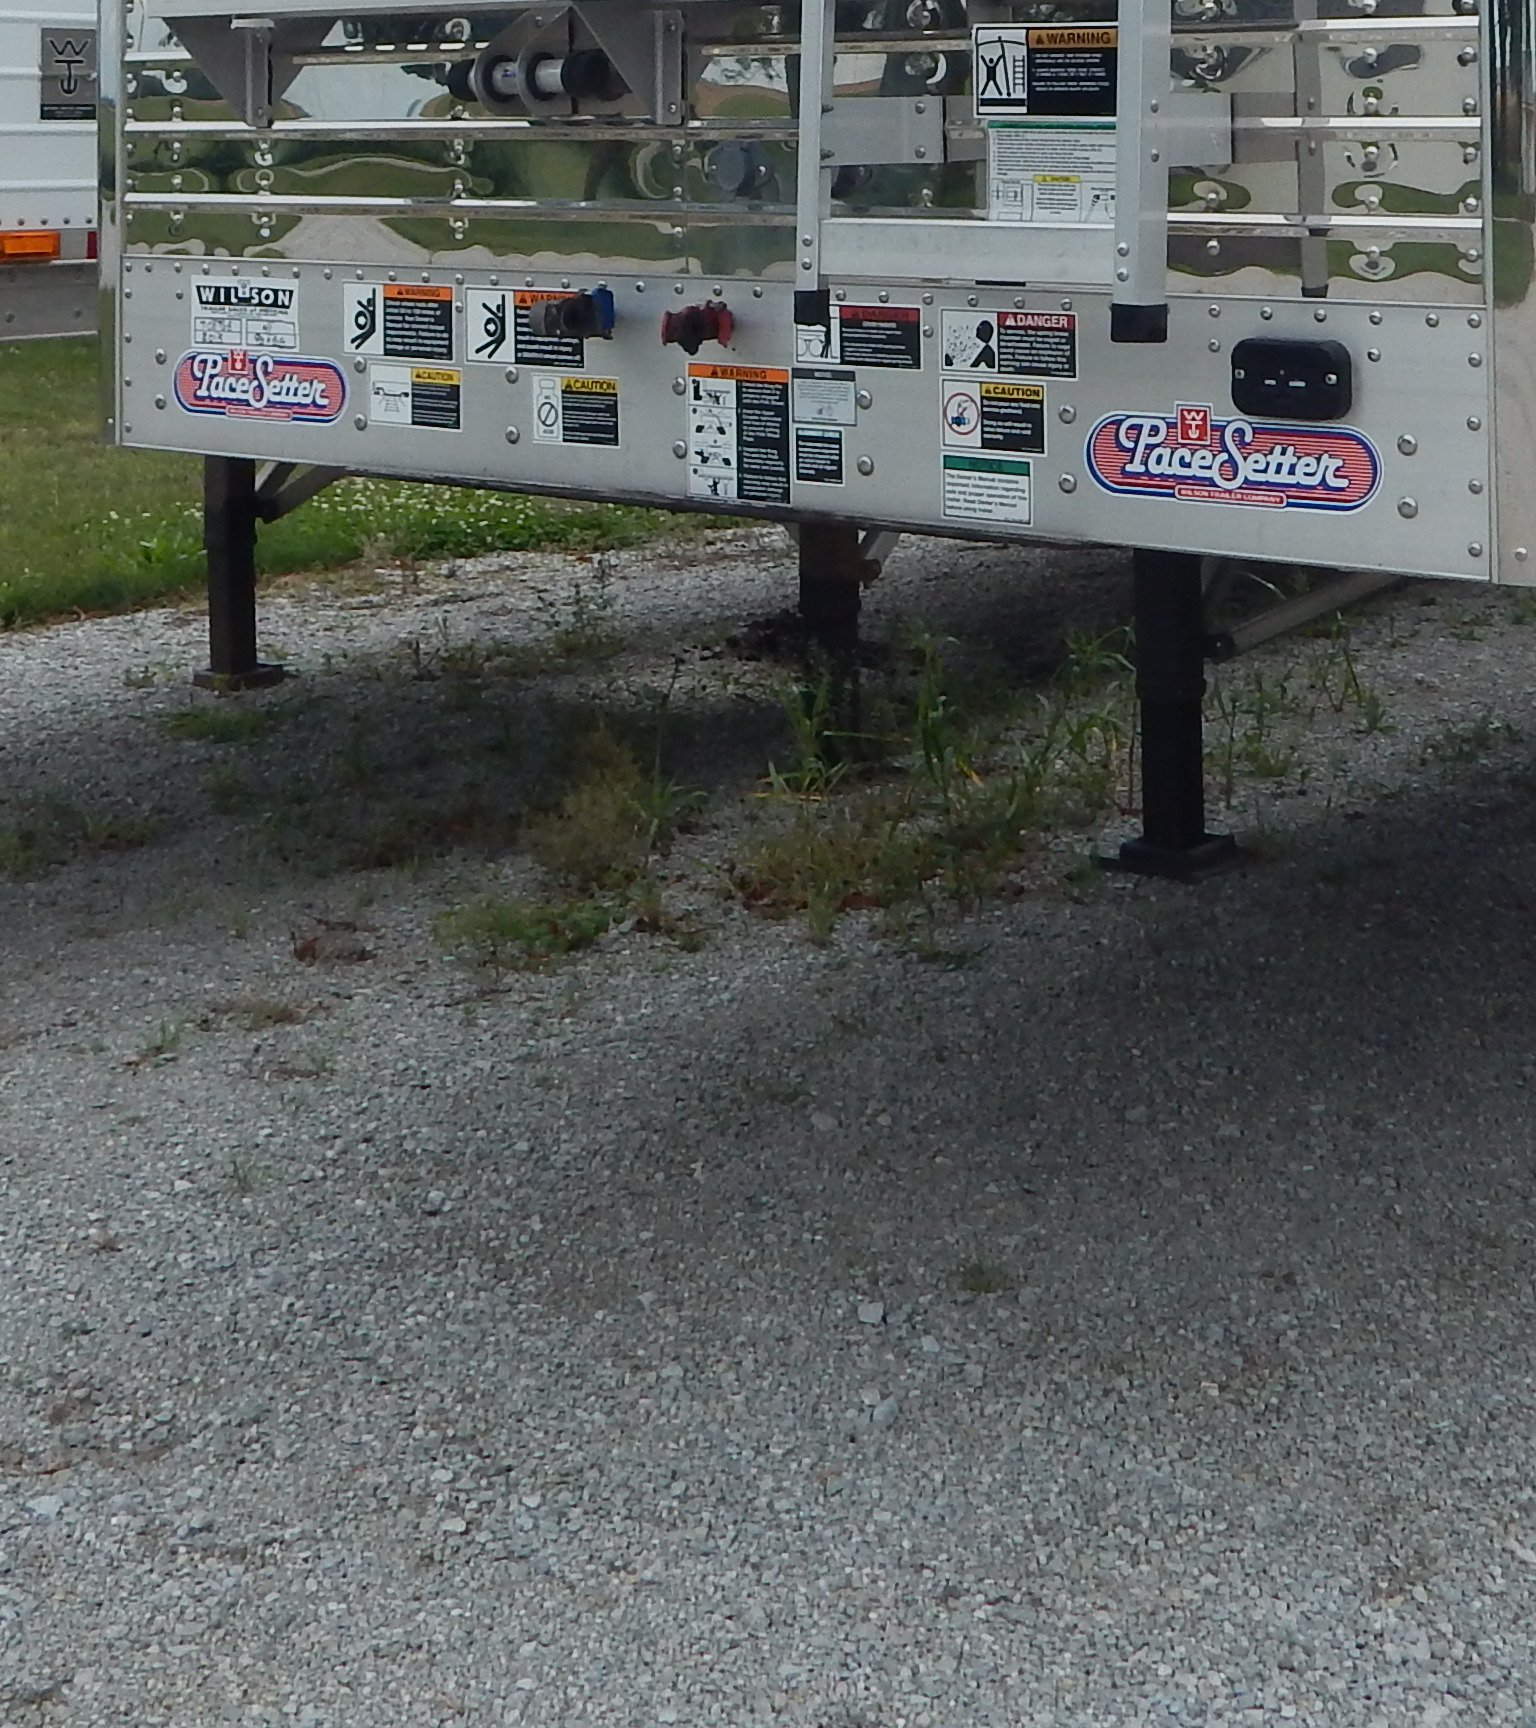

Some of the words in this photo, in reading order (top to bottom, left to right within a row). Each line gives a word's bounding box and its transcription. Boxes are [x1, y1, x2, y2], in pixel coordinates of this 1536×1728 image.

[1046, 32, 1111, 45] WARNING
[200, 286, 290, 306] WILSON
[1016, 314, 1068, 328] DANGER
[721, 368, 767, 380] WARNING
[573, 379, 616, 391] CAUTION
[992, 386, 1040, 397] CAUTION
